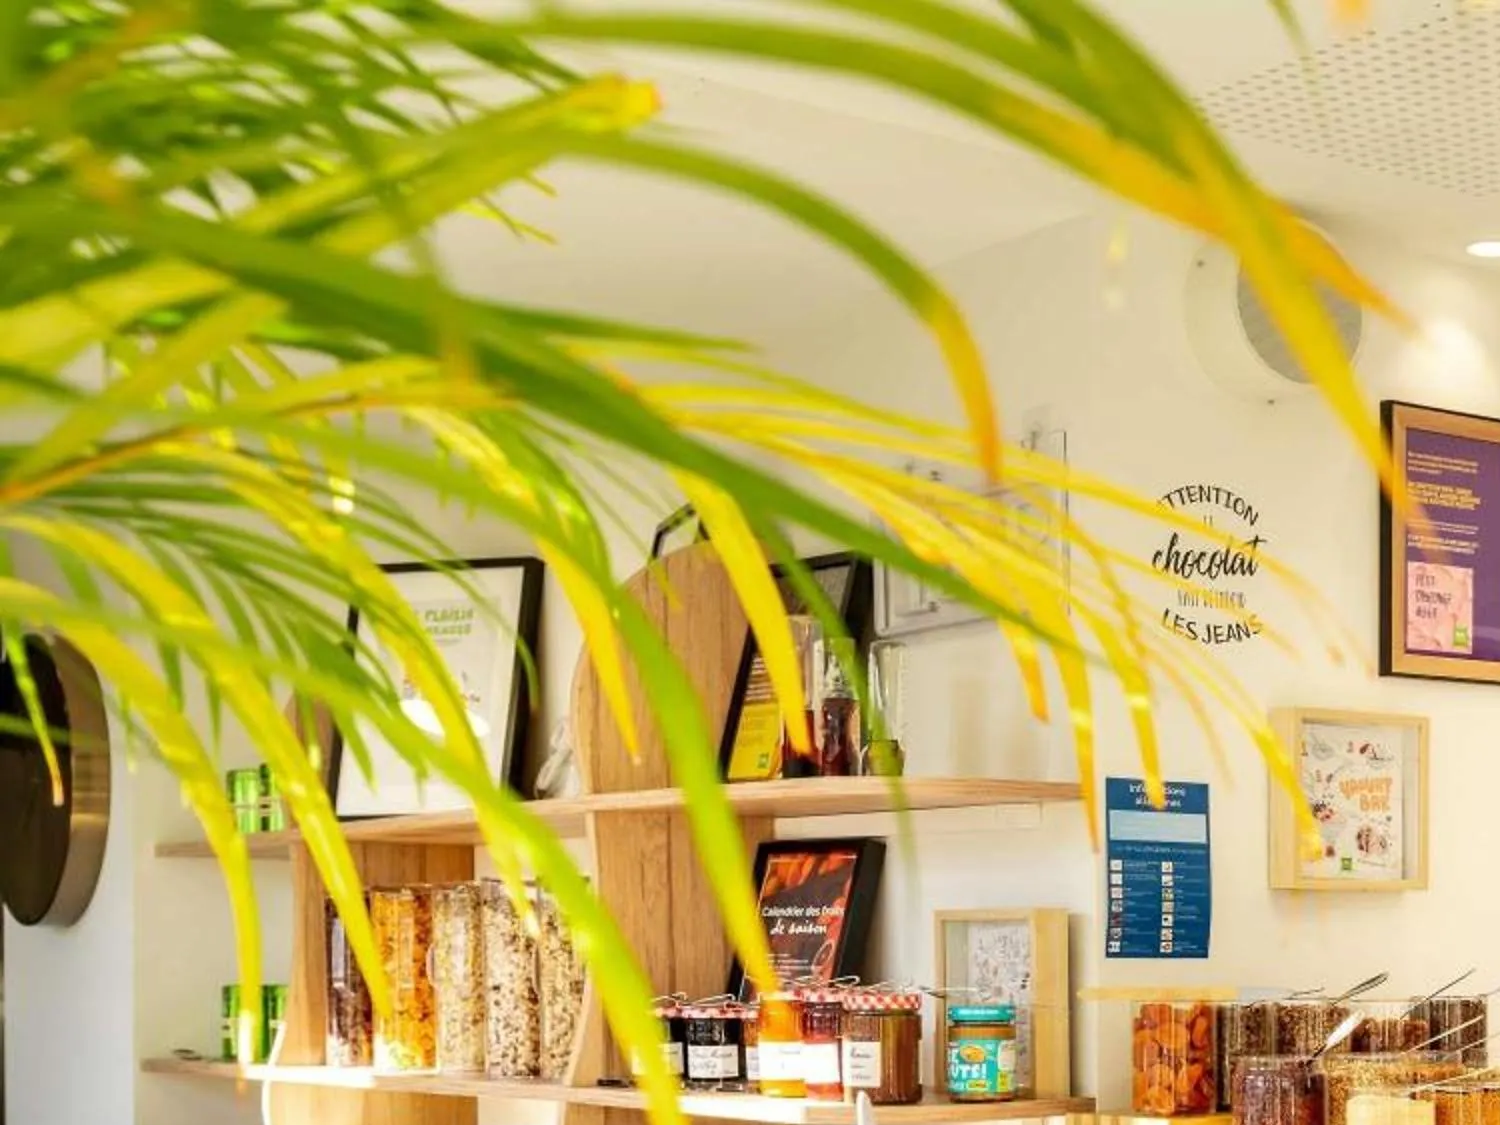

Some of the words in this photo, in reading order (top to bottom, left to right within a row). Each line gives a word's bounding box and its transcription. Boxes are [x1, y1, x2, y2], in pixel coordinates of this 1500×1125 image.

[1151, 531, 1268, 580] chocolat
[1162, 607, 1199, 641] LES
[1201, 613, 1264, 645] JEANS
[762, 905, 804, 917] Calendrier
[805, 905, 821, 917] des
[769, 918, 785, 935] de
[787, 919, 827, 935] saison
